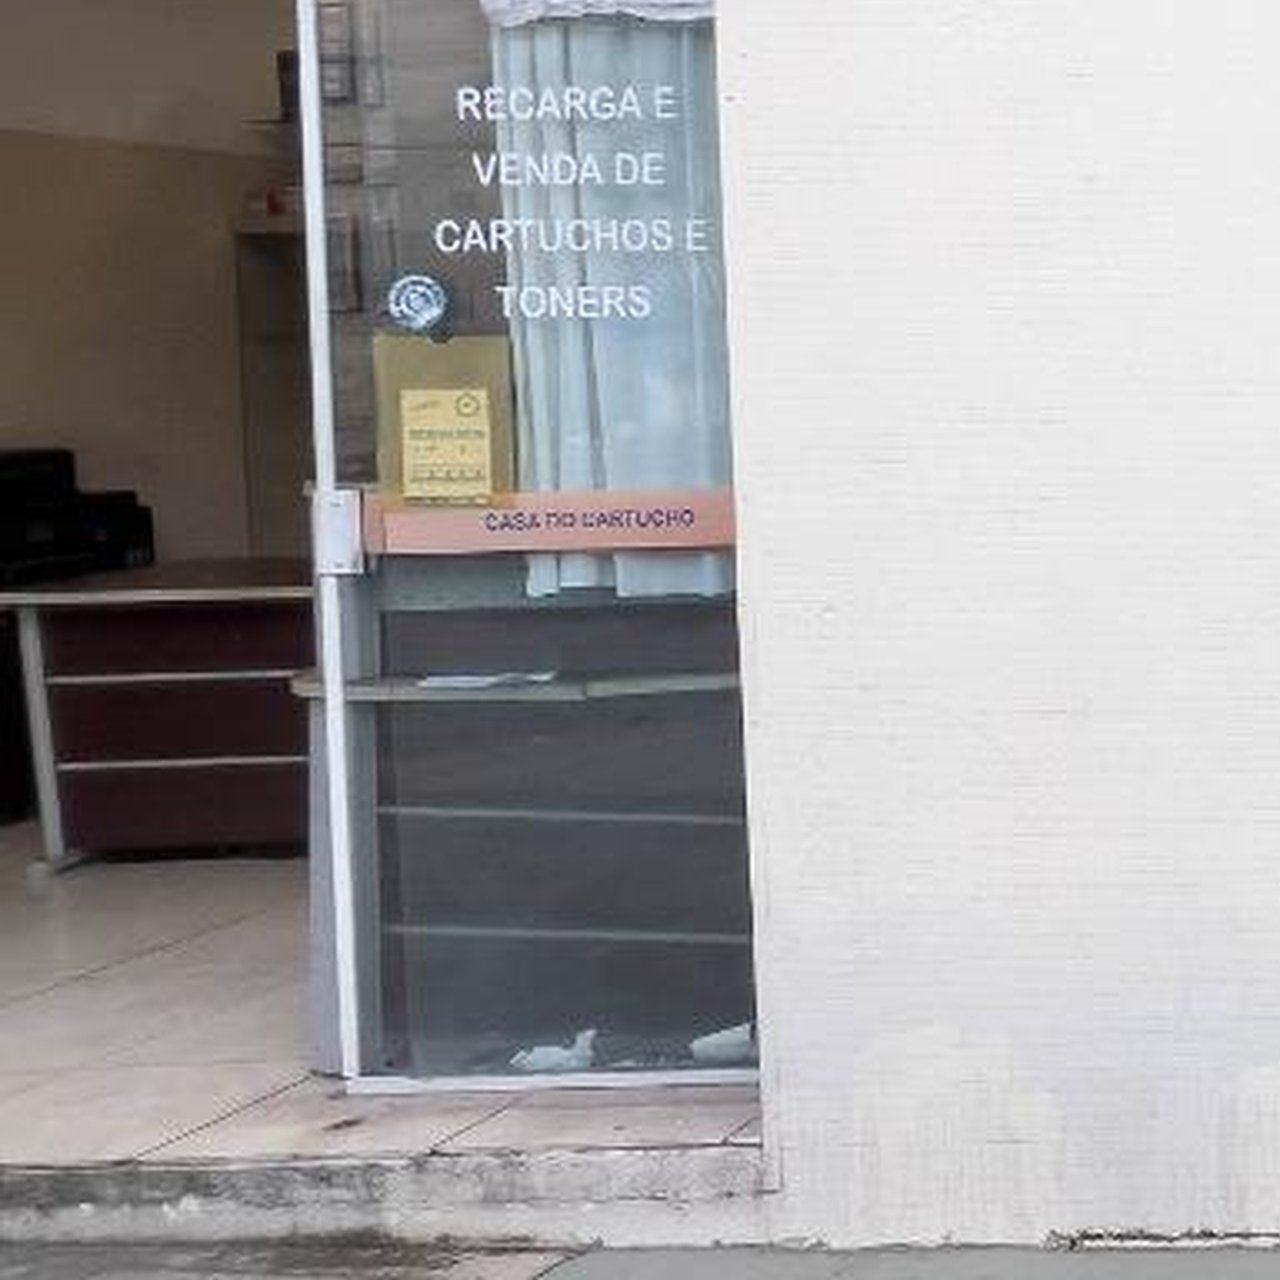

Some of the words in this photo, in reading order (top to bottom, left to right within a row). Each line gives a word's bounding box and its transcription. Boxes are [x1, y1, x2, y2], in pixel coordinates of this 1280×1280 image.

[457, 87, 642, 121] RECARGA
[656, 87, 677, 119] E
[472, 153, 602, 187] VENDA
[615, 153, 666, 186] DE
[434, 220, 673, 253] CARTUCHOS
[686, 222, 709, 252] E
[496, 285, 652, 318] TONERS
[484, 511, 541, 532] CASA
